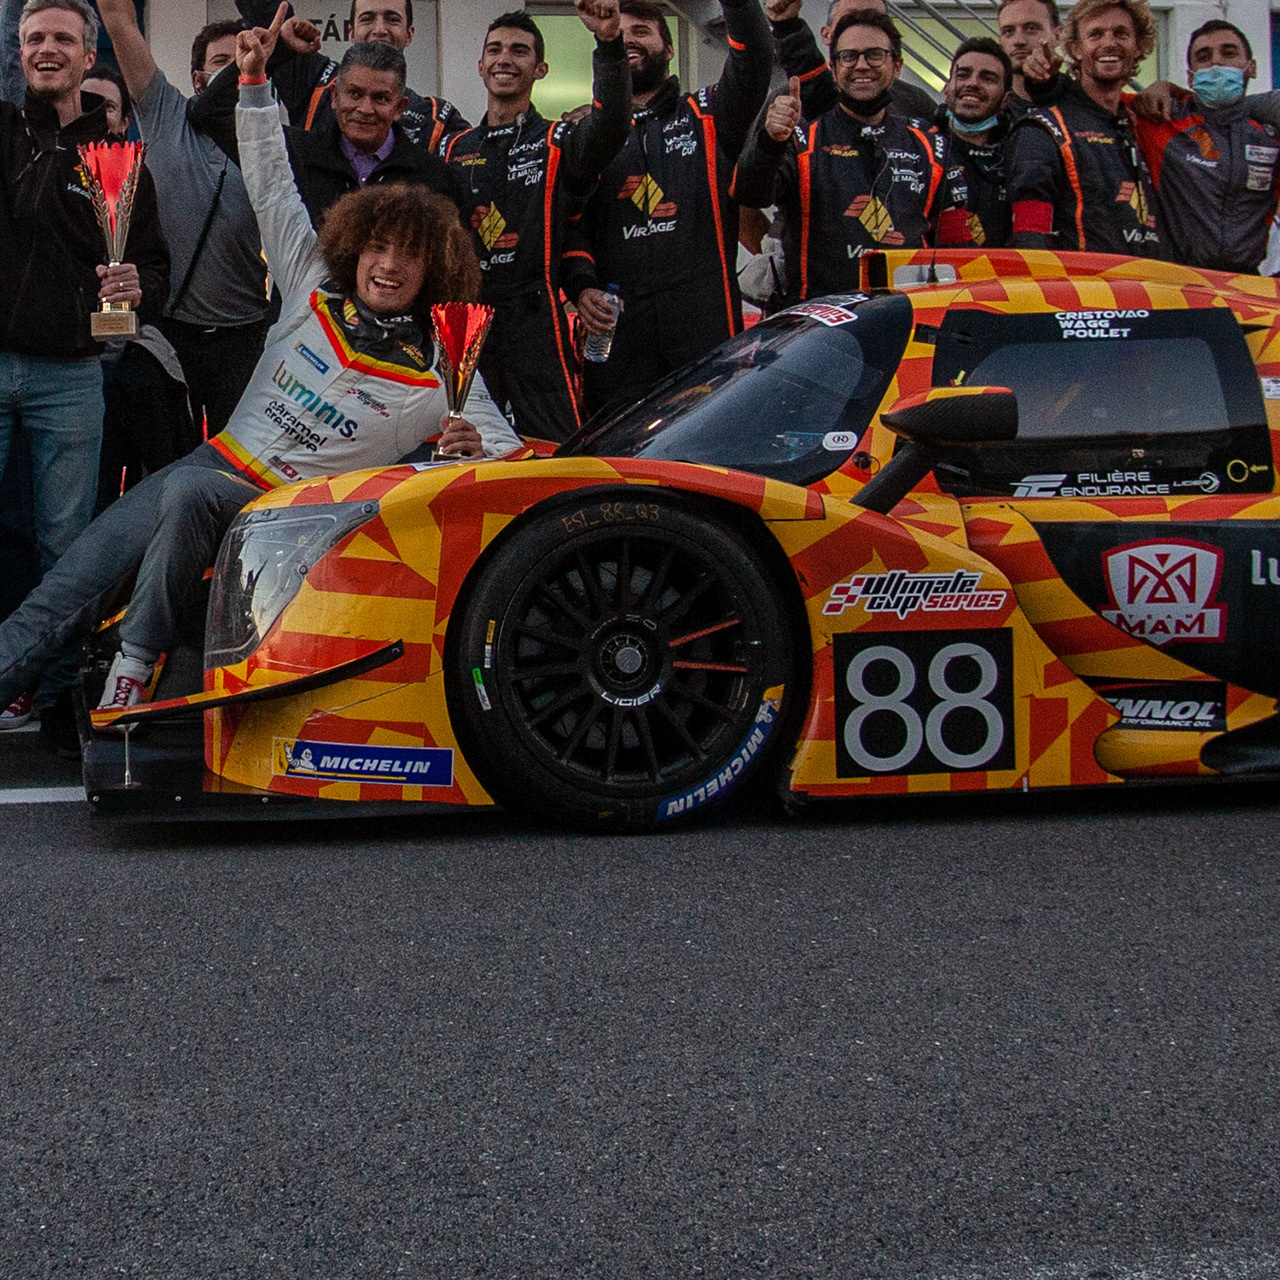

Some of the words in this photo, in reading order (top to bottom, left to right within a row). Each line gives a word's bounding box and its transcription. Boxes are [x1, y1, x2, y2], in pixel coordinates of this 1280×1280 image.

[524, 171, 544, 186] CUP
[622, 220, 677, 241] VIRAGE
[479, 251, 516, 270] RAGE
[1054, 309, 1150, 320] CRISTOVAO
[1058, 319, 1111, 329] WAGG
[1062, 327, 1132, 338] POULET
[264, 407, 318, 453] creative
[1076, 469, 1151, 484] FILIÈRE
[1060, 483, 1170, 497] ENDURANCE
[1117, 612, 1206, 635] MAM
[600, 682, 662, 707] LIGIER
[843, 642, 1005, 773] 88
[1106, 697, 1218, 721] NNOL
[1121, 717, 1192, 728] ERFORMANCE
[318, 752, 432, 775] MICHELIN
[666, 727, 764, 817] MICHELIN
